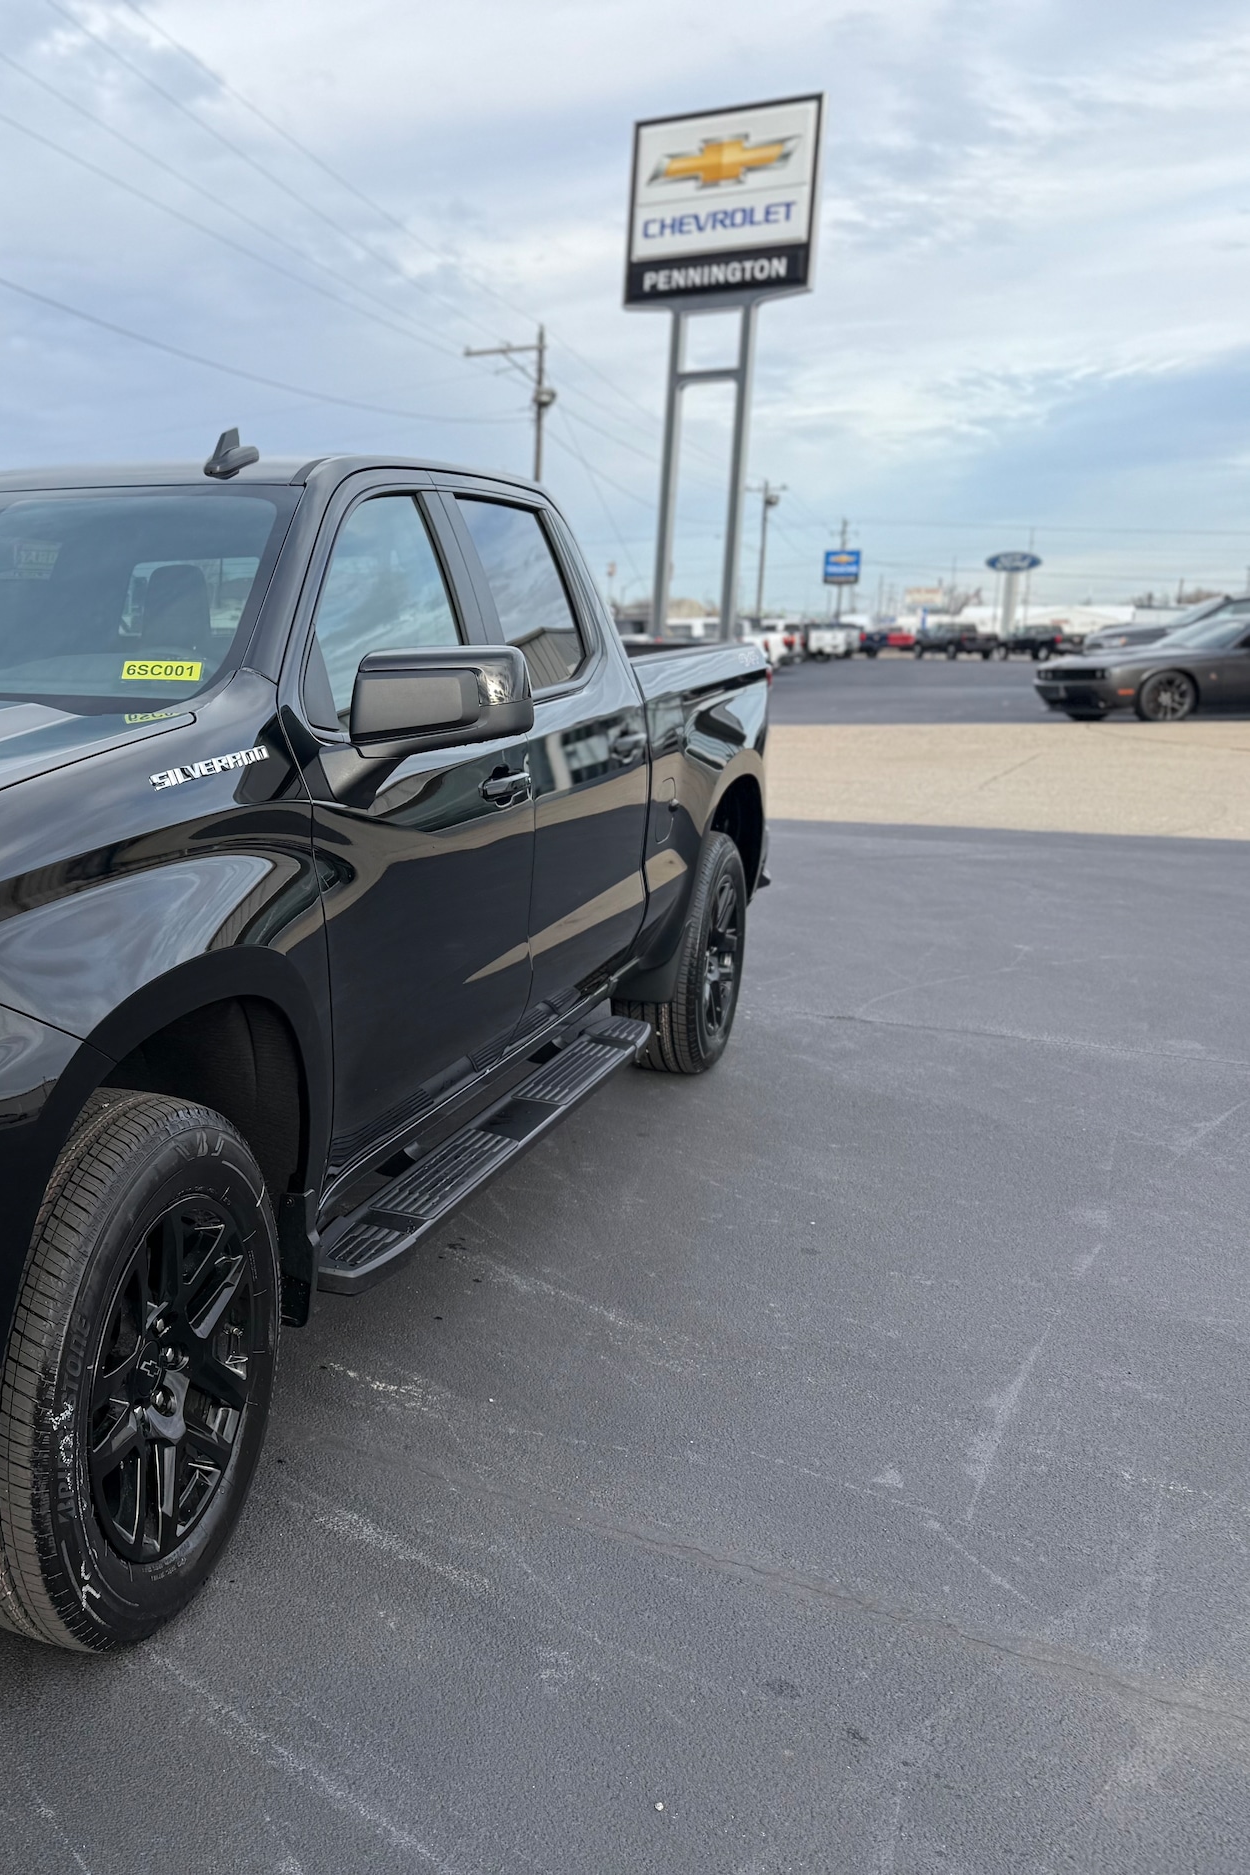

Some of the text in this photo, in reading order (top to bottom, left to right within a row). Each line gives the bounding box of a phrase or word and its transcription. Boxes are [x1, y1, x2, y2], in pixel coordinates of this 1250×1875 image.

[642, 200, 796, 240] CHEVROLET
[642, 256, 788, 293] PENNINGTON
[125, 664, 195, 677] 6SC001
[149, 745, 270, 791] SILVERADO
